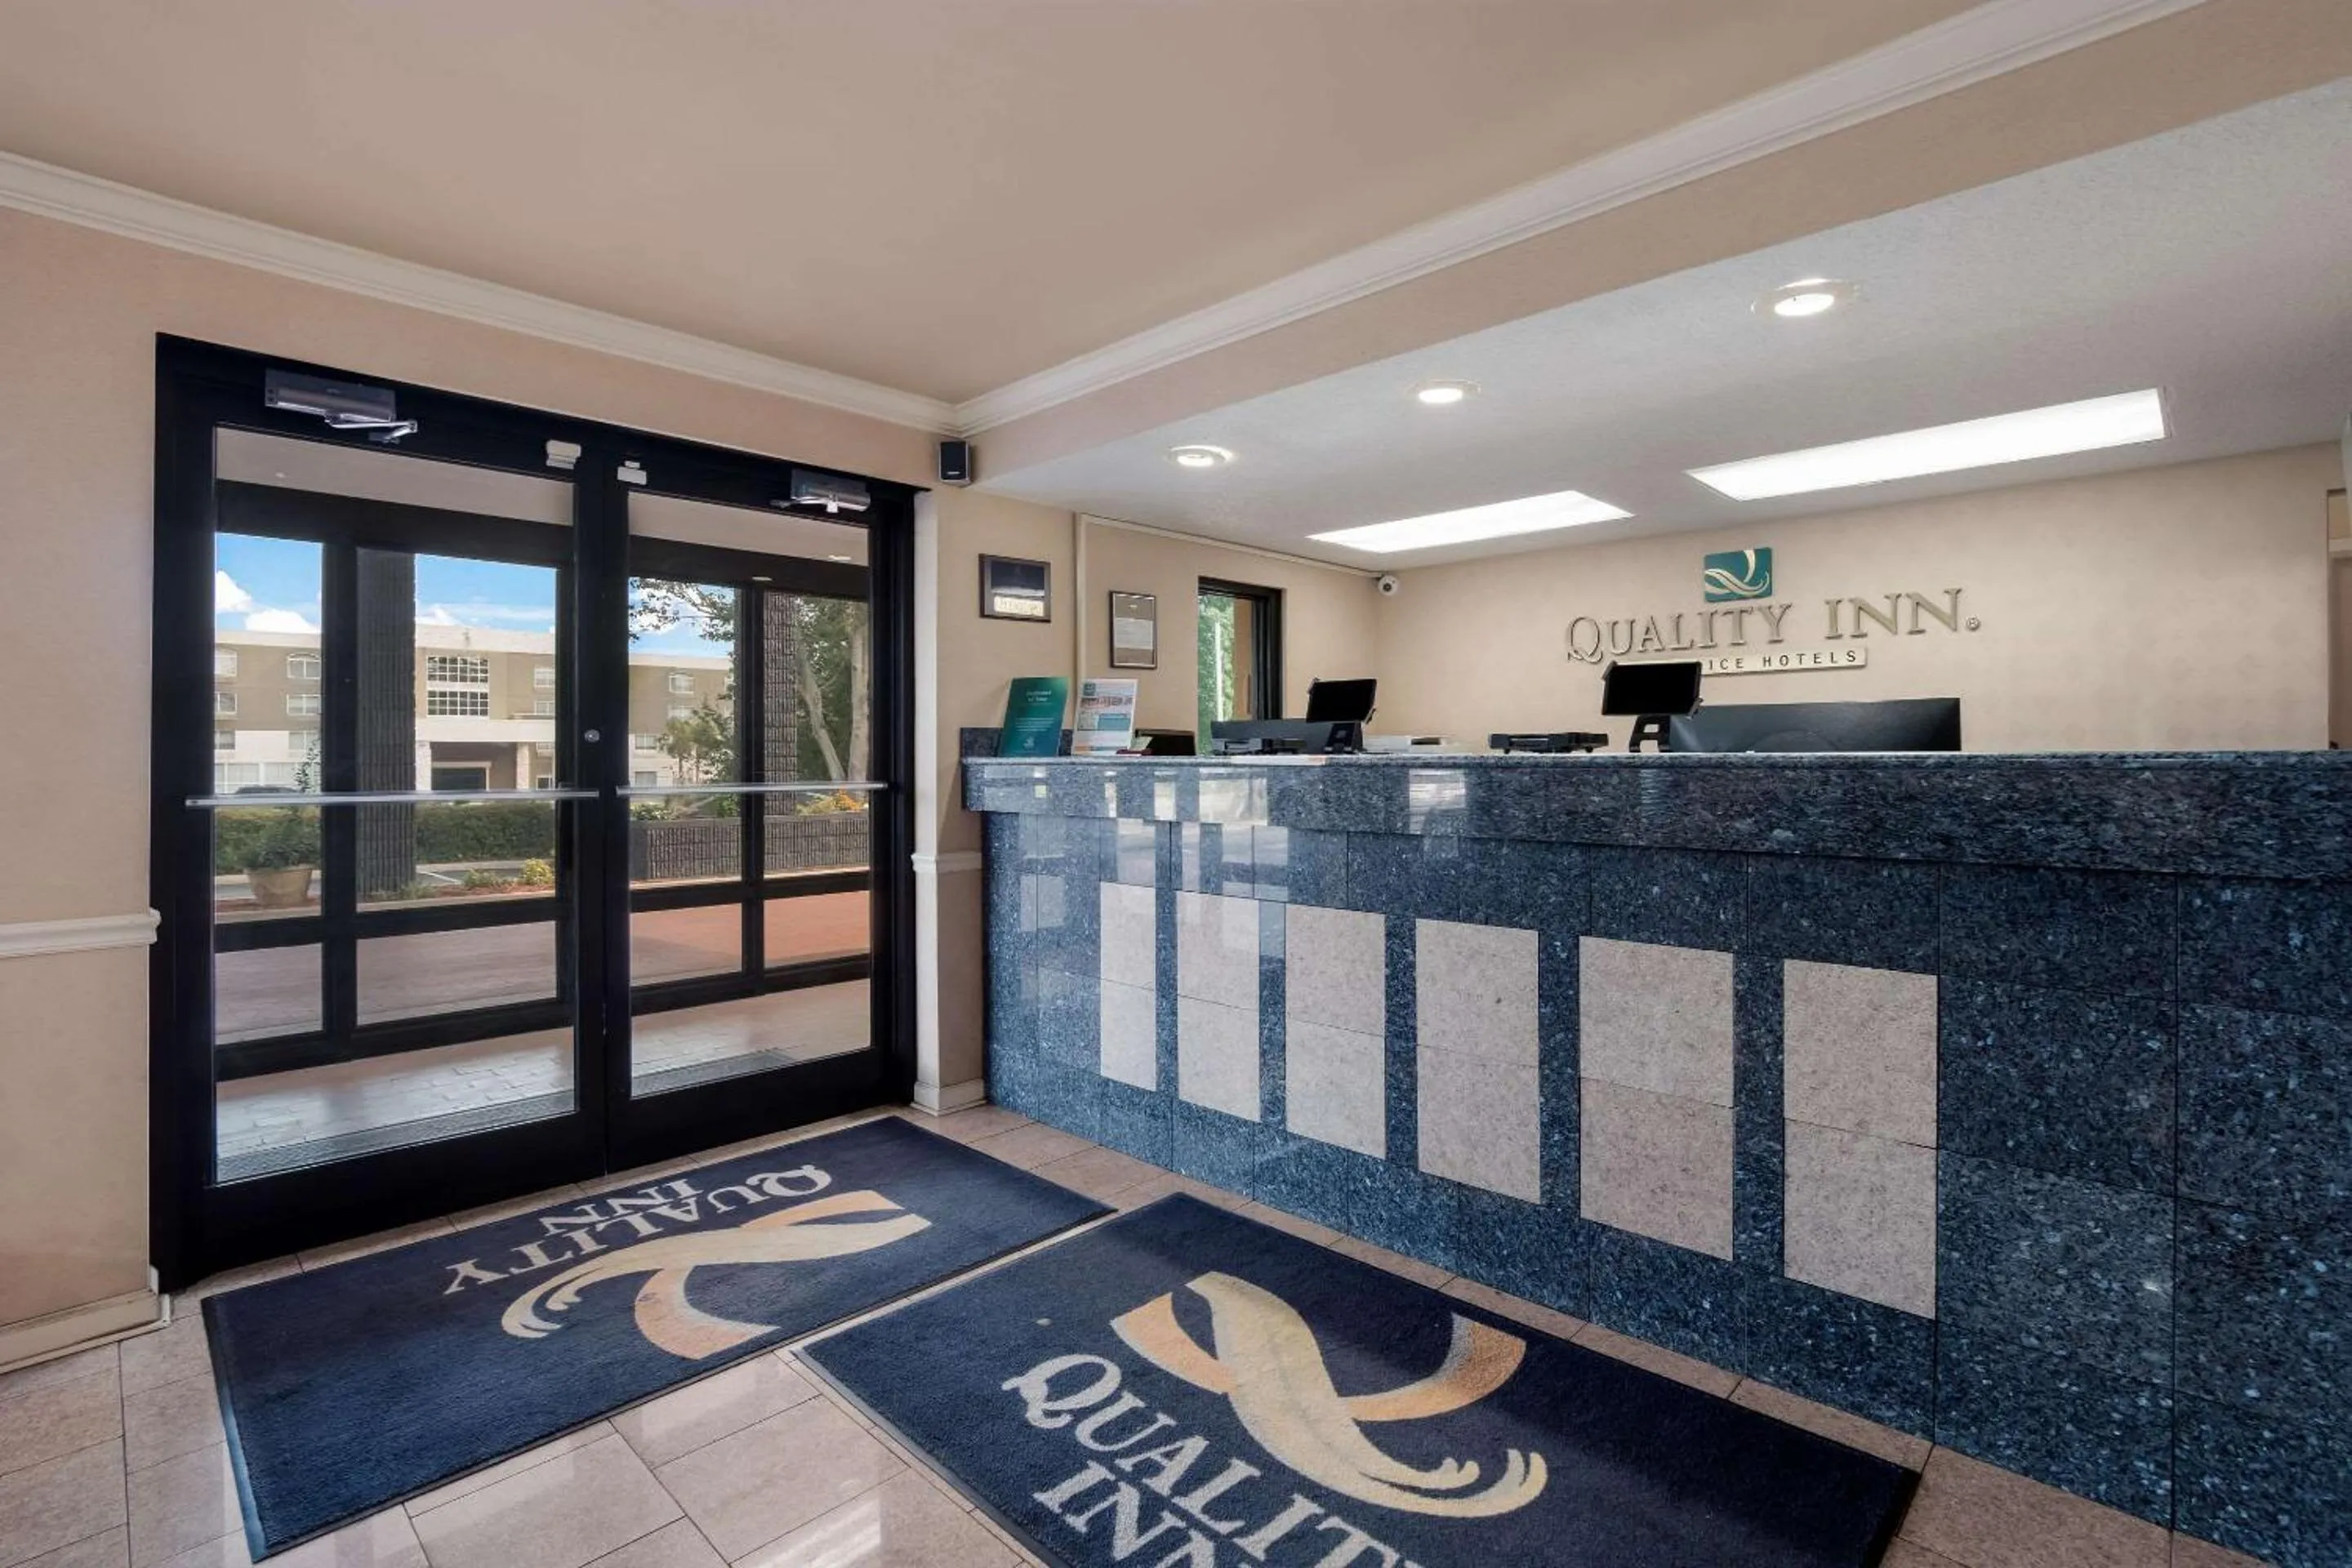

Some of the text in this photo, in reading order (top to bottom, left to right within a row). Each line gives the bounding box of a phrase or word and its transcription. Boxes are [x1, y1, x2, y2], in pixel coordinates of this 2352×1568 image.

[1566, 603, 1793, 665] QUALITY
[1762, 650, 1857, 667] HOTELS
[443, 1164, 833, 1295] QUALITY
[540, 1178, 702, 1236] INN
[1002, 1353, 1425, 1568] QUALIT
